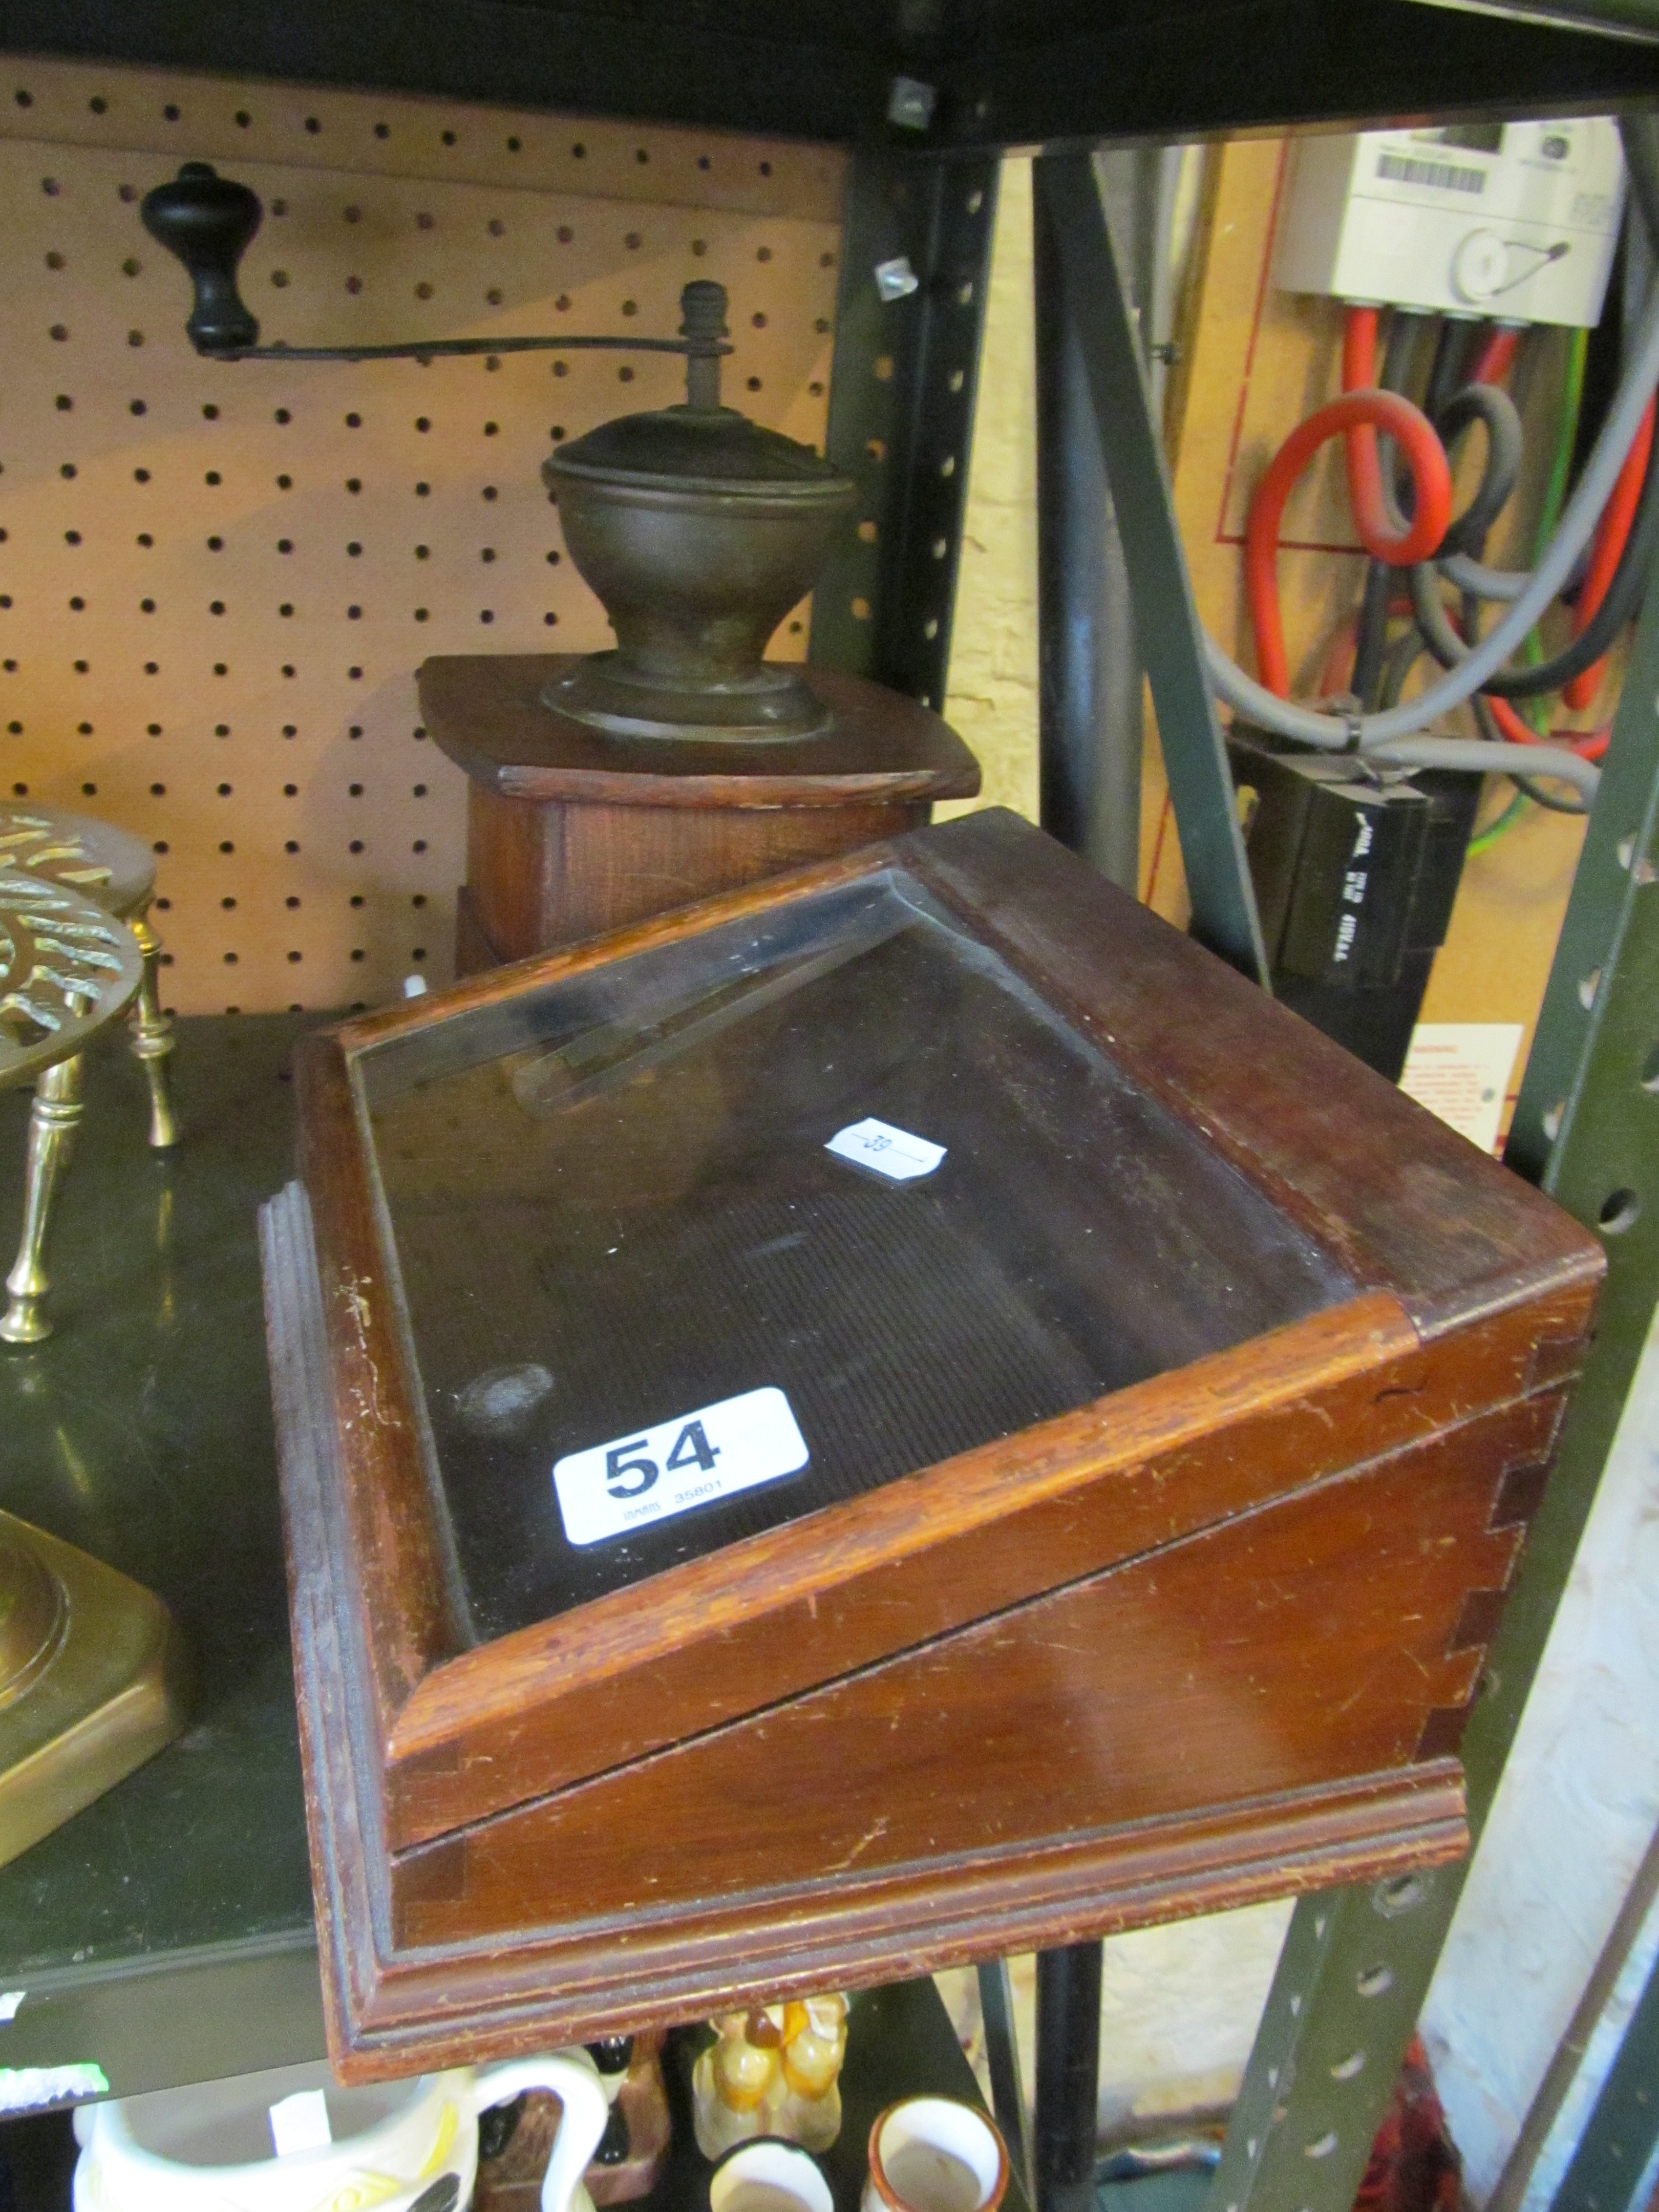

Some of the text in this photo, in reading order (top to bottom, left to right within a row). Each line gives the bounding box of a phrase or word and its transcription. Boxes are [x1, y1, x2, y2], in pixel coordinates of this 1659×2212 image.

[863, 1135, 892, 1152] 39
[606, 1419, 721, 1499] 54
[674, 1480, 722, 1504] 35801
